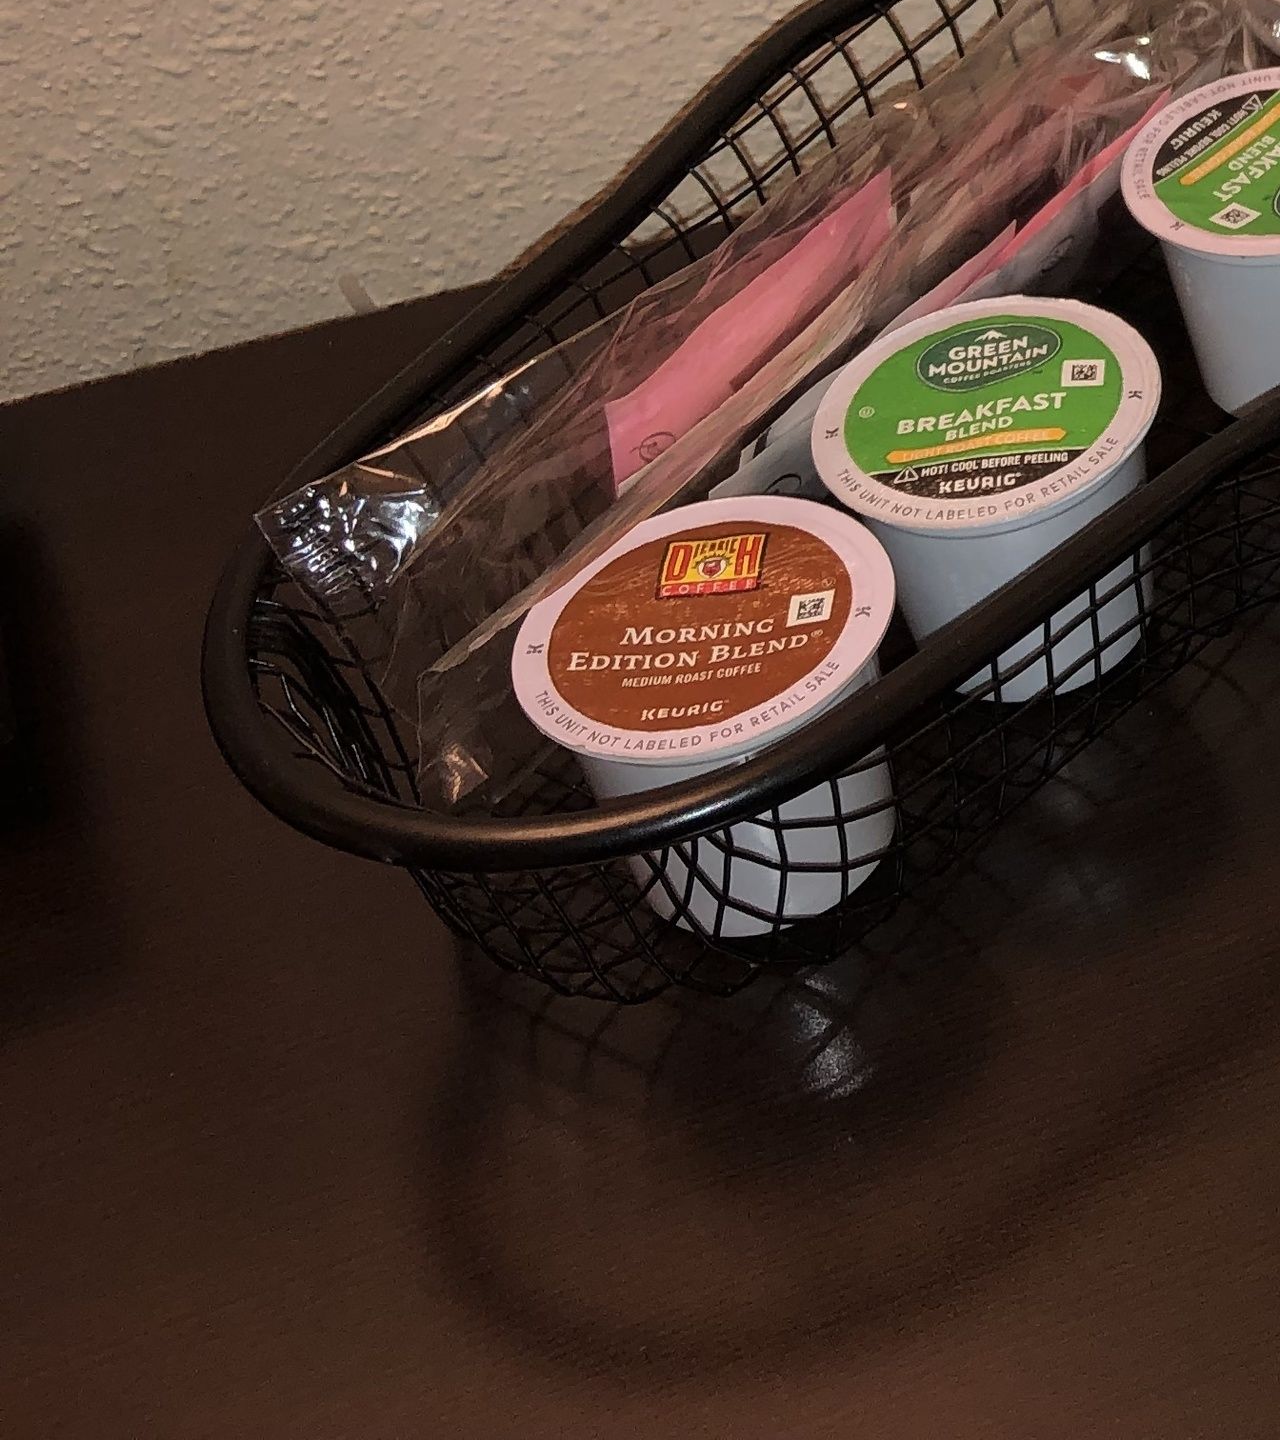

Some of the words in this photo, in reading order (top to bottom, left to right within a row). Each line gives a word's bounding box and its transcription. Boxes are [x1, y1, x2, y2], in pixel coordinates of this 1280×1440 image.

[1169, 109, 1223, 151] KEURIG
[1228, 135, 1277, 171] BLEND
[928, 343, 1049, 378] MOUNTAIN
[948, 335, 1029, 361] GREEN
[943, 372, 981, 385] COFFEE
[896, 392, 1067, 436] BREAKFAST
[944, 416, 1014, 442] BLEND
[920, 465, 949, 478] HOT!
[951, 460, 978, 472] COOL
[981, 455, 1021, 468] BEFORE
[1023, 451, 1069, 464] PEELING
[837, 468, 861, 493] THIS
[859, 489, 889, 511] UNIT
[890, 502, 921, 518] NOT
[925, 504, 998, 521] LABELED
[1004, 492, 1037, 512] FOR
[1040, 465, 1090, 496] RETAIL
[1088, 436, 1120, 467] SALE
[938, 473, 1017, 495] KEURIG
[661, 579, 757, 597] COFFEE
[619, 618, 775, 646] MORNING
[566, 651, 700, 672] EDITION
[621, 674, 672, 689] MEDIUM
[674, 670, 714, 685] ROAST
[716, 662, 763, 678] COFFEE
[535, 689, 556, 717] THIS
[554, 712, 588, 739] UNIT
[587, 730, 622, 748] NOT
[623, 735, 702, 751] LABELED
[710, 723, 744, 742] FOR
[750, 691, 806, 728] RETAIL
[805, 660, 841, 693] SALE
[640, 700, 725, 721] KEURIG
